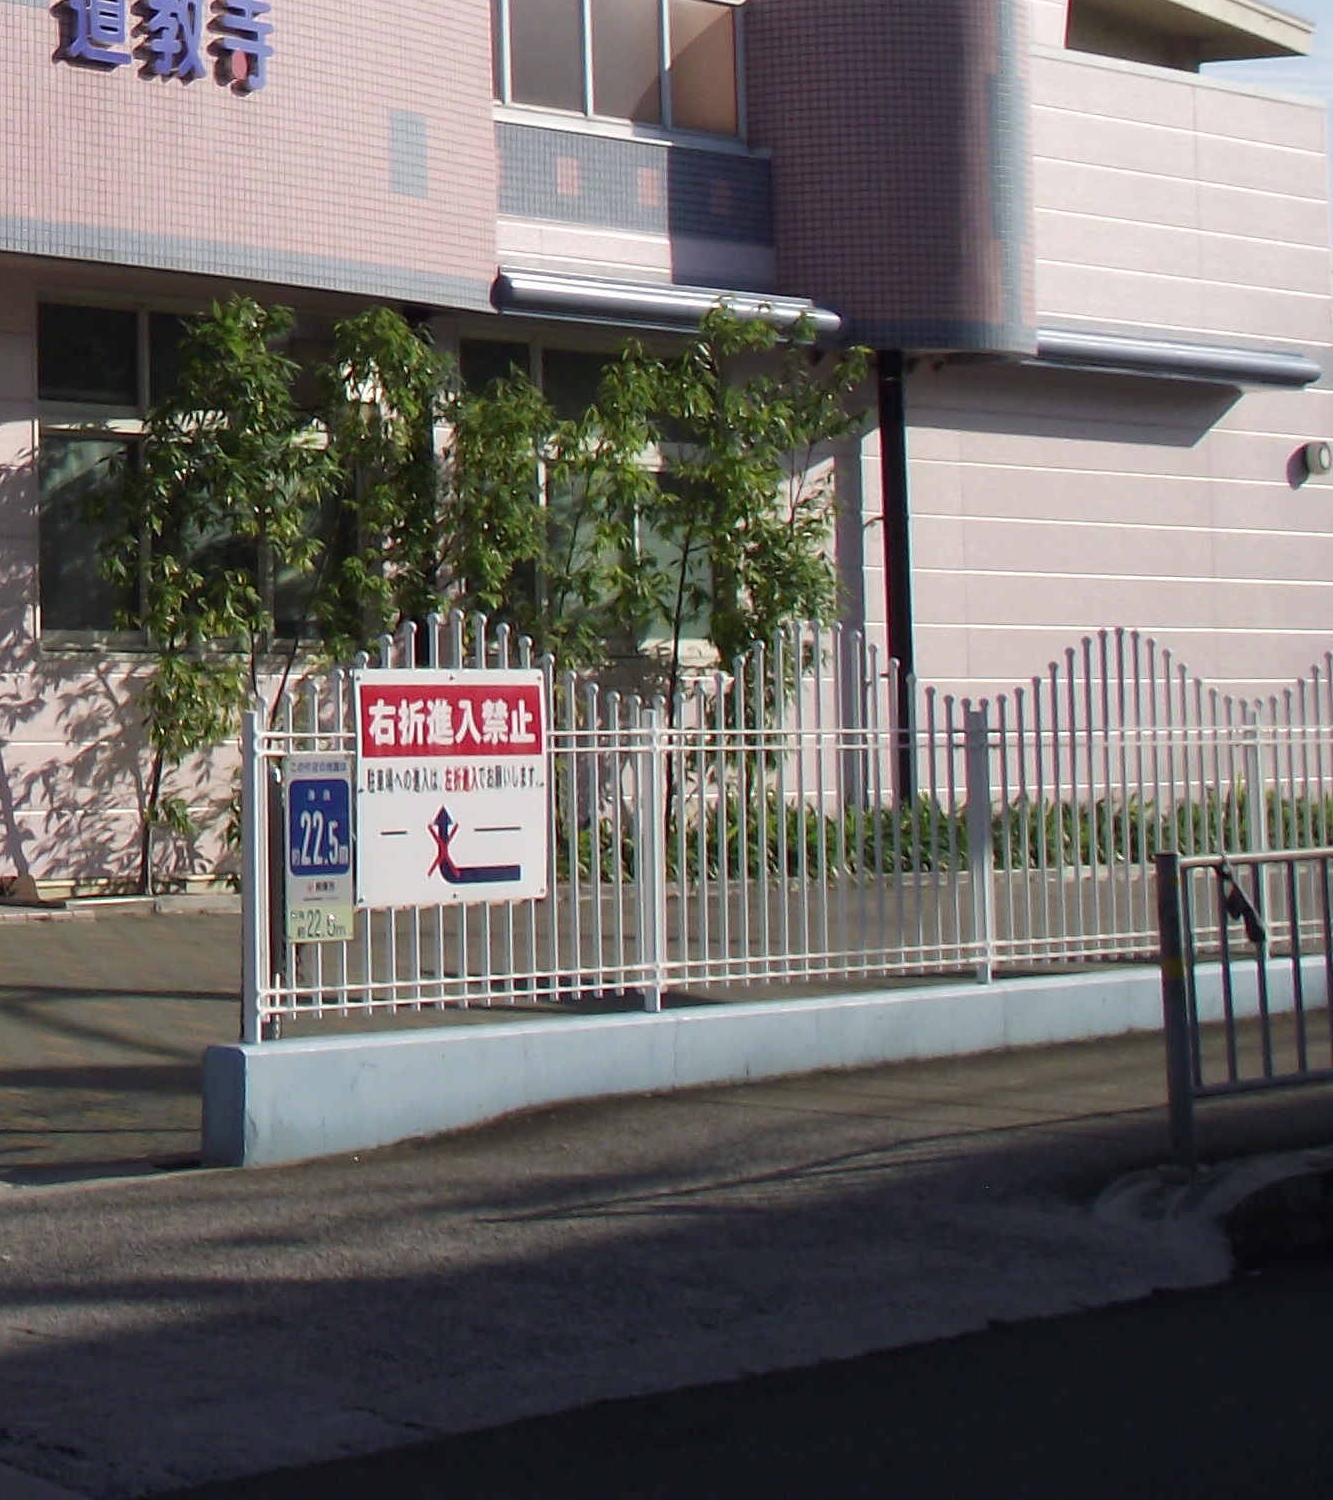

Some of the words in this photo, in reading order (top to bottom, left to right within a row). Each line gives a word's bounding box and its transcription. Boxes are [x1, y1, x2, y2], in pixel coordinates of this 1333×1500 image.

[367, 698, 537, 748] 右折進入禁止
